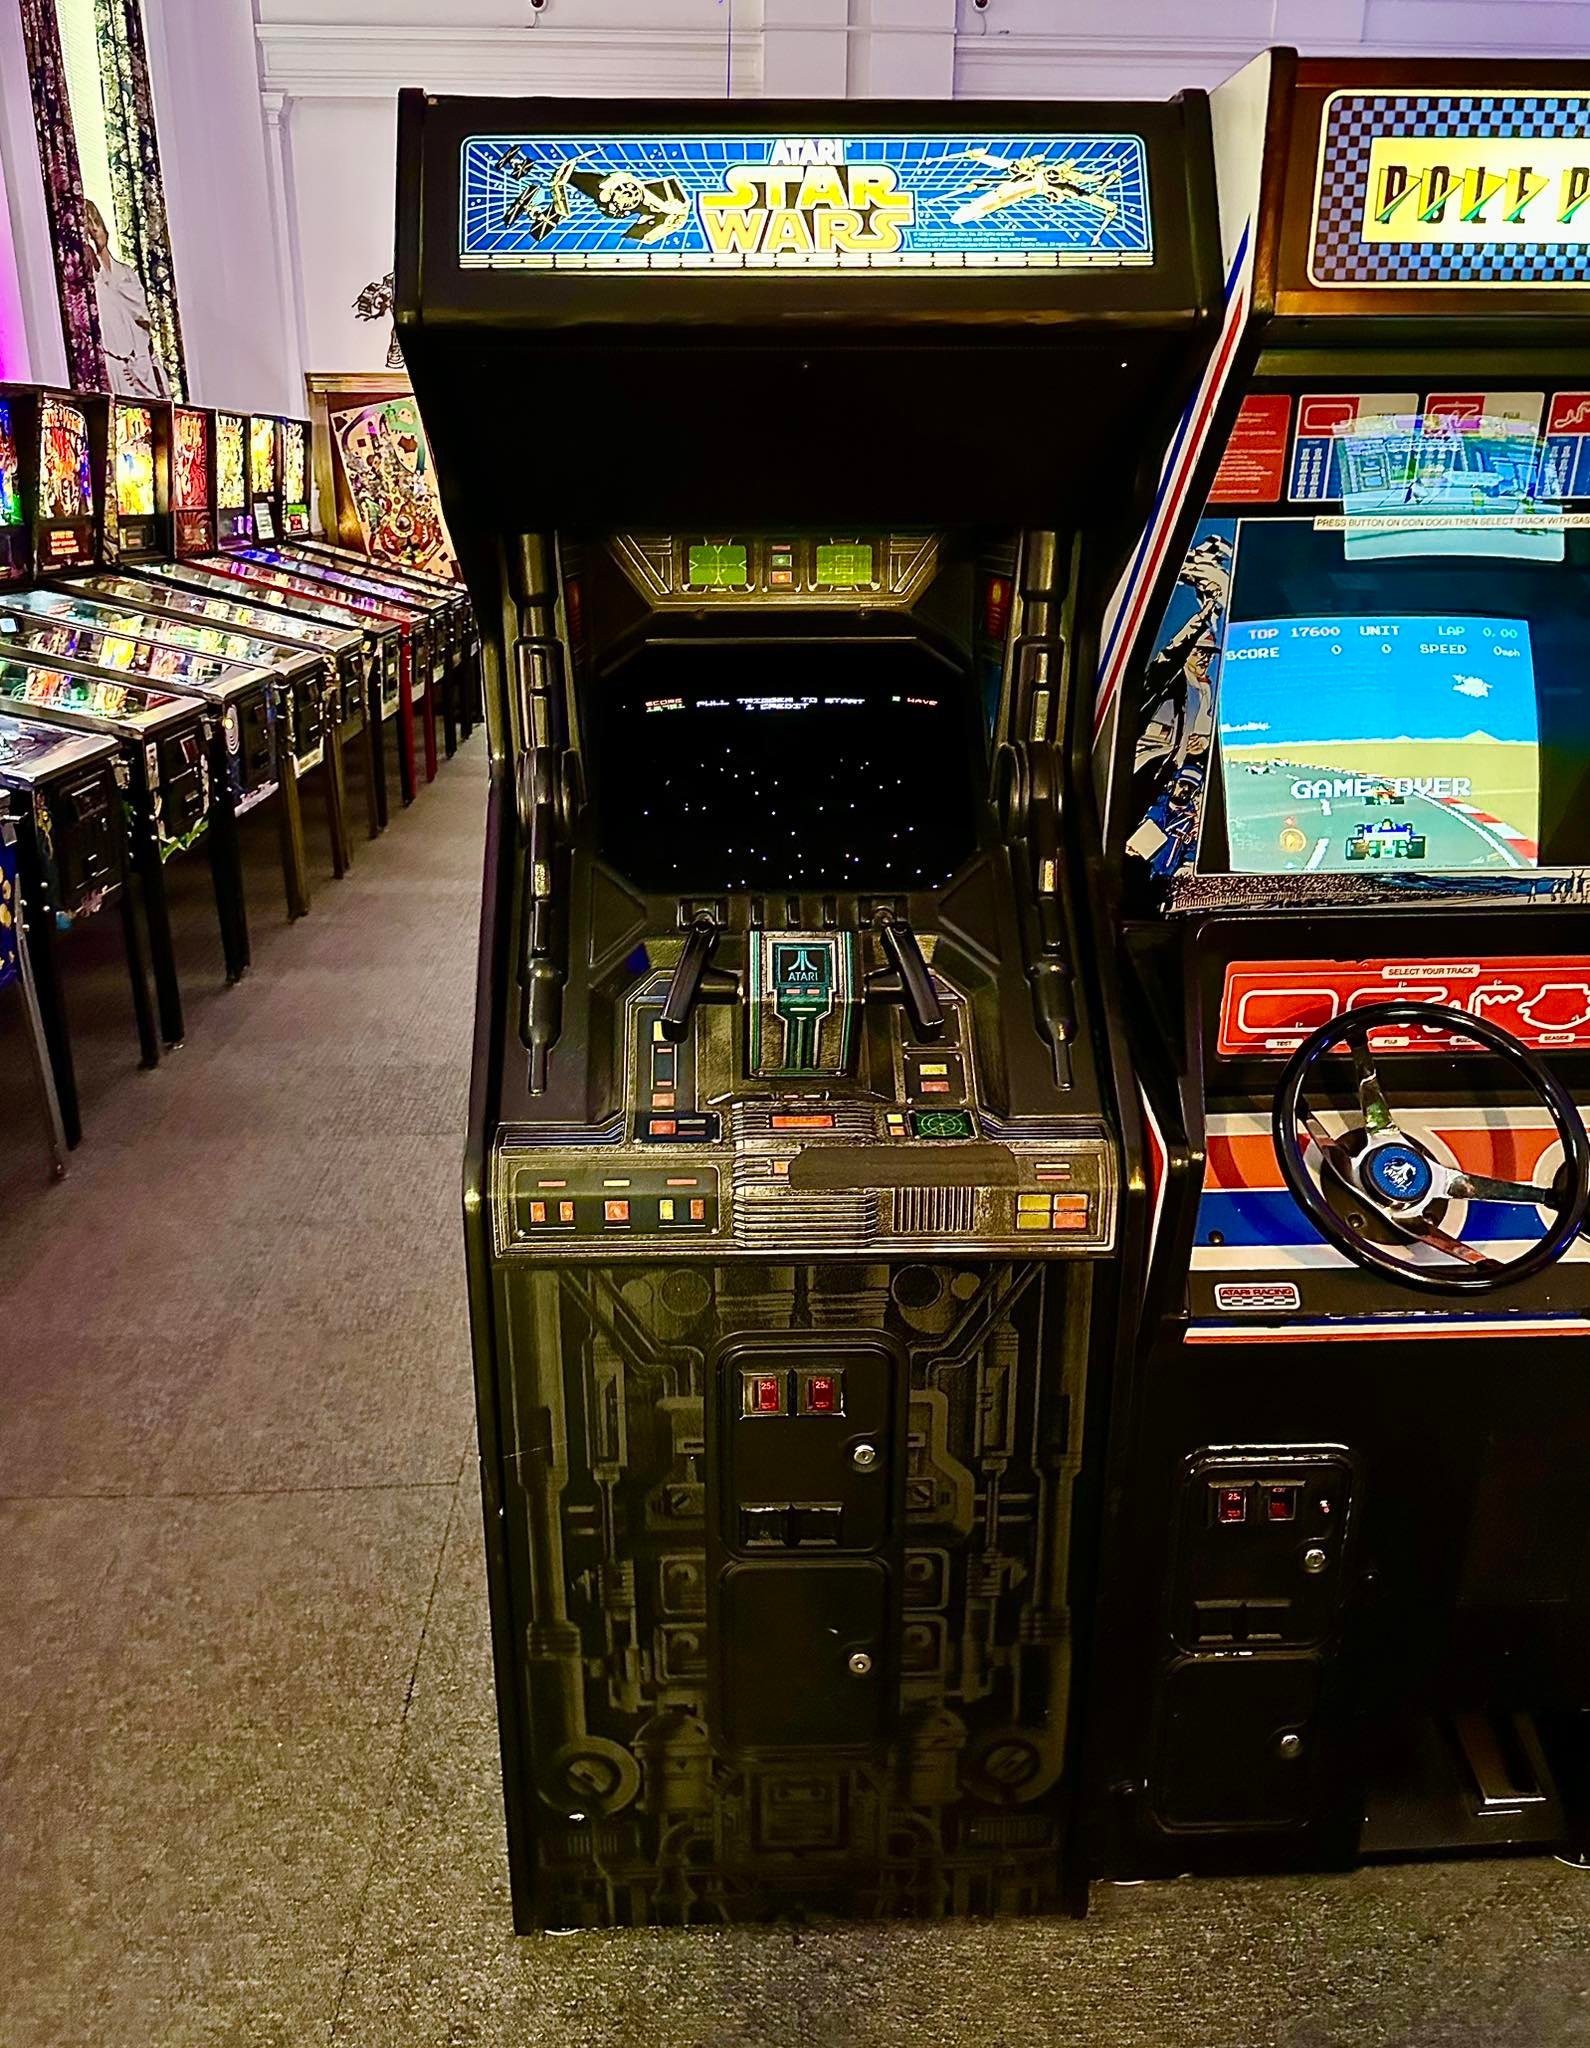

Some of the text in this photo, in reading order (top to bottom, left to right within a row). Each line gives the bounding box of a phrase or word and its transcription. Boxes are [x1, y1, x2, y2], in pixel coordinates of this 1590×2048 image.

[769, 139, 846, 166] ATARI
[698, 165, 915, 210] STAR
[701, 208, 916, 254] WARS
[1316, 518, 1347, 527] PRESS
[1348, 518, 1385, 527] BUTTON
[1386, 518, 1400, 526] ON
[1401, 518, 1424, 526] COIN
[1455, 517, 1478, 525] THEN
[1480, 517, 1514, 526] SELECT
[1516, 516, 1546, 525] TRACK
[1547, 516, 1570, 524] WITH
[1248, 627, 1279, 640] TOP
[1290, 626, 1341, 638] 17600
[1359, 625, 1400, 636] UNIT
[1438, 625, 1465, 636] LAP
[1225, 647, 1280, 661] SCORE
[1330, 644, 1342, 655] 0
[1381, 643, 1392, 654] 0
[1419, 643, 1468, 655] SPEED
[696, 699, 730, 708] PULL
[907, 697, 938, 706] WAVE
[760, 703, 809, 711] CREDIT
[1290, 776, 1472, 800] GAME OVER
[788, 971, 818, 982] ATARI
[1388, 966, 1474, 976] SELECT YOUR TRACK
[1221, 1287, 1292, 1296] ATARI RACING
